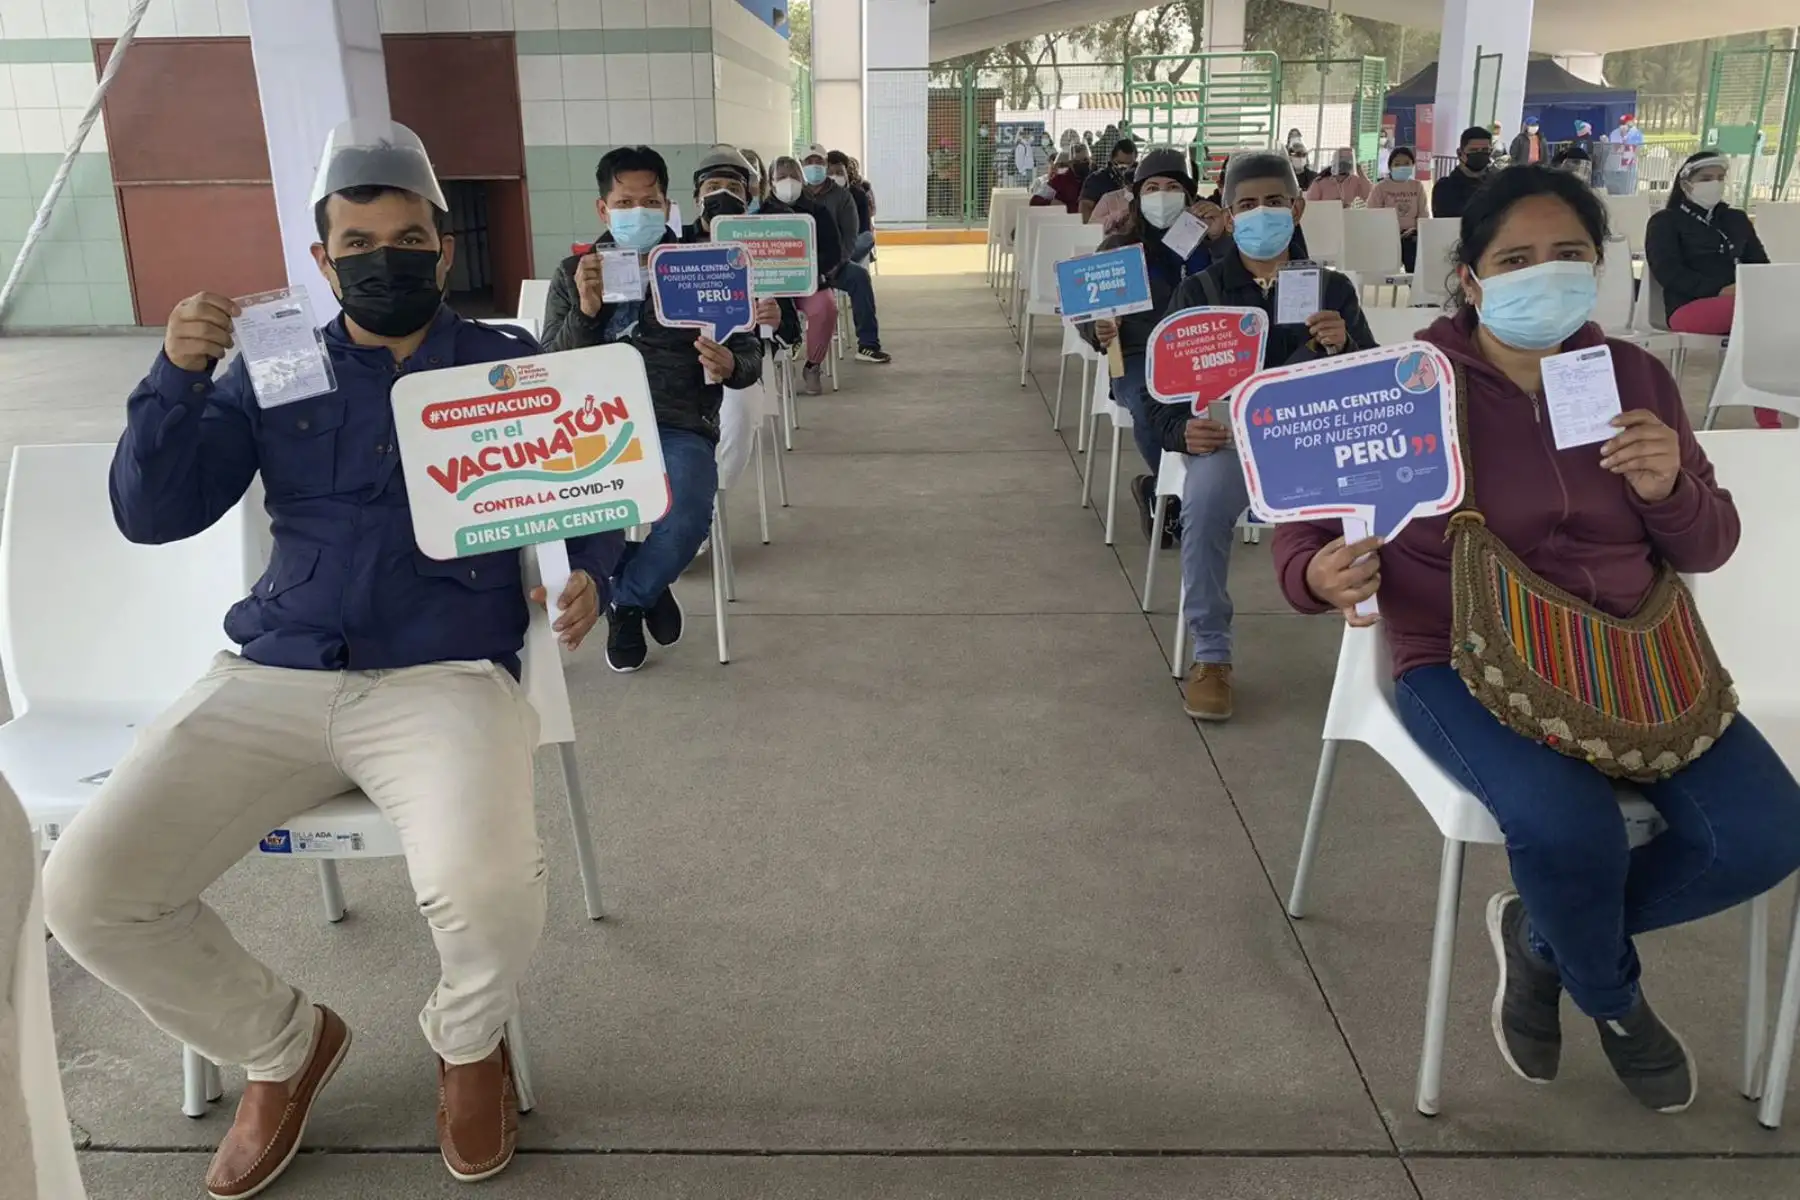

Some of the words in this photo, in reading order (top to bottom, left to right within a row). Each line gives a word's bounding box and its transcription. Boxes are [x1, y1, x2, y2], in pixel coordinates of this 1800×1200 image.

[663, 273, 696, 282] PONEMOS
[706, 272, 736, 280] HOMBRO
[670, 265, 680, 273] EN
[681, 264, 700, 273] LIMA
[701, 264, 730, 272] CENTRO
[678, 282, 692, 290] POR
[692, 281, 723, 290] NUESTRO
[697, 286, 732, 303] PERÚ
[1087, 282, 1100, 304] 2
[1176, 322, 1209, 338] DIRIS
[1176, 335, 1216, 349] RECUERDA
[1216, 331, 1233, 341] QUE
[1184, 344, 1216, 356] VACUNA
[1217, 339, 1239, 350] TIENE
[1192, 356, 1201, 371] 2
[1201, 349, 1236, 369] DOSIS
[429, 394, 554, 424] #YOMEVACUNO
[1276, 406, 1297, 421] EN
[1299, 397, 1339, 417] LIMA
[1341, 387, 1402, 409] CENTRO
[471, 425, 498, 443] en
[504, 419, 524, 438] el
[1263, 417, 1331, 440] PONEMOS
[1334, 414, 1349, 427] EL
[1353, 401, 1415, 424] HOMBRO
[1294, 436, 1322, 450] POR
[1325, 422, 1388, 444] NUESTRO
[1334, 429, 1408, 468] PERÚ
[473, 496, 536, 515] CONTRA
[537, 492, 556, 505] LA
[558, 478, 625, 499] COVID-19
[465, 524, 511, 545] DIRIS
[516, 518, 560, 537] LIMA
[562, 505, 629, 528] CENTRO
